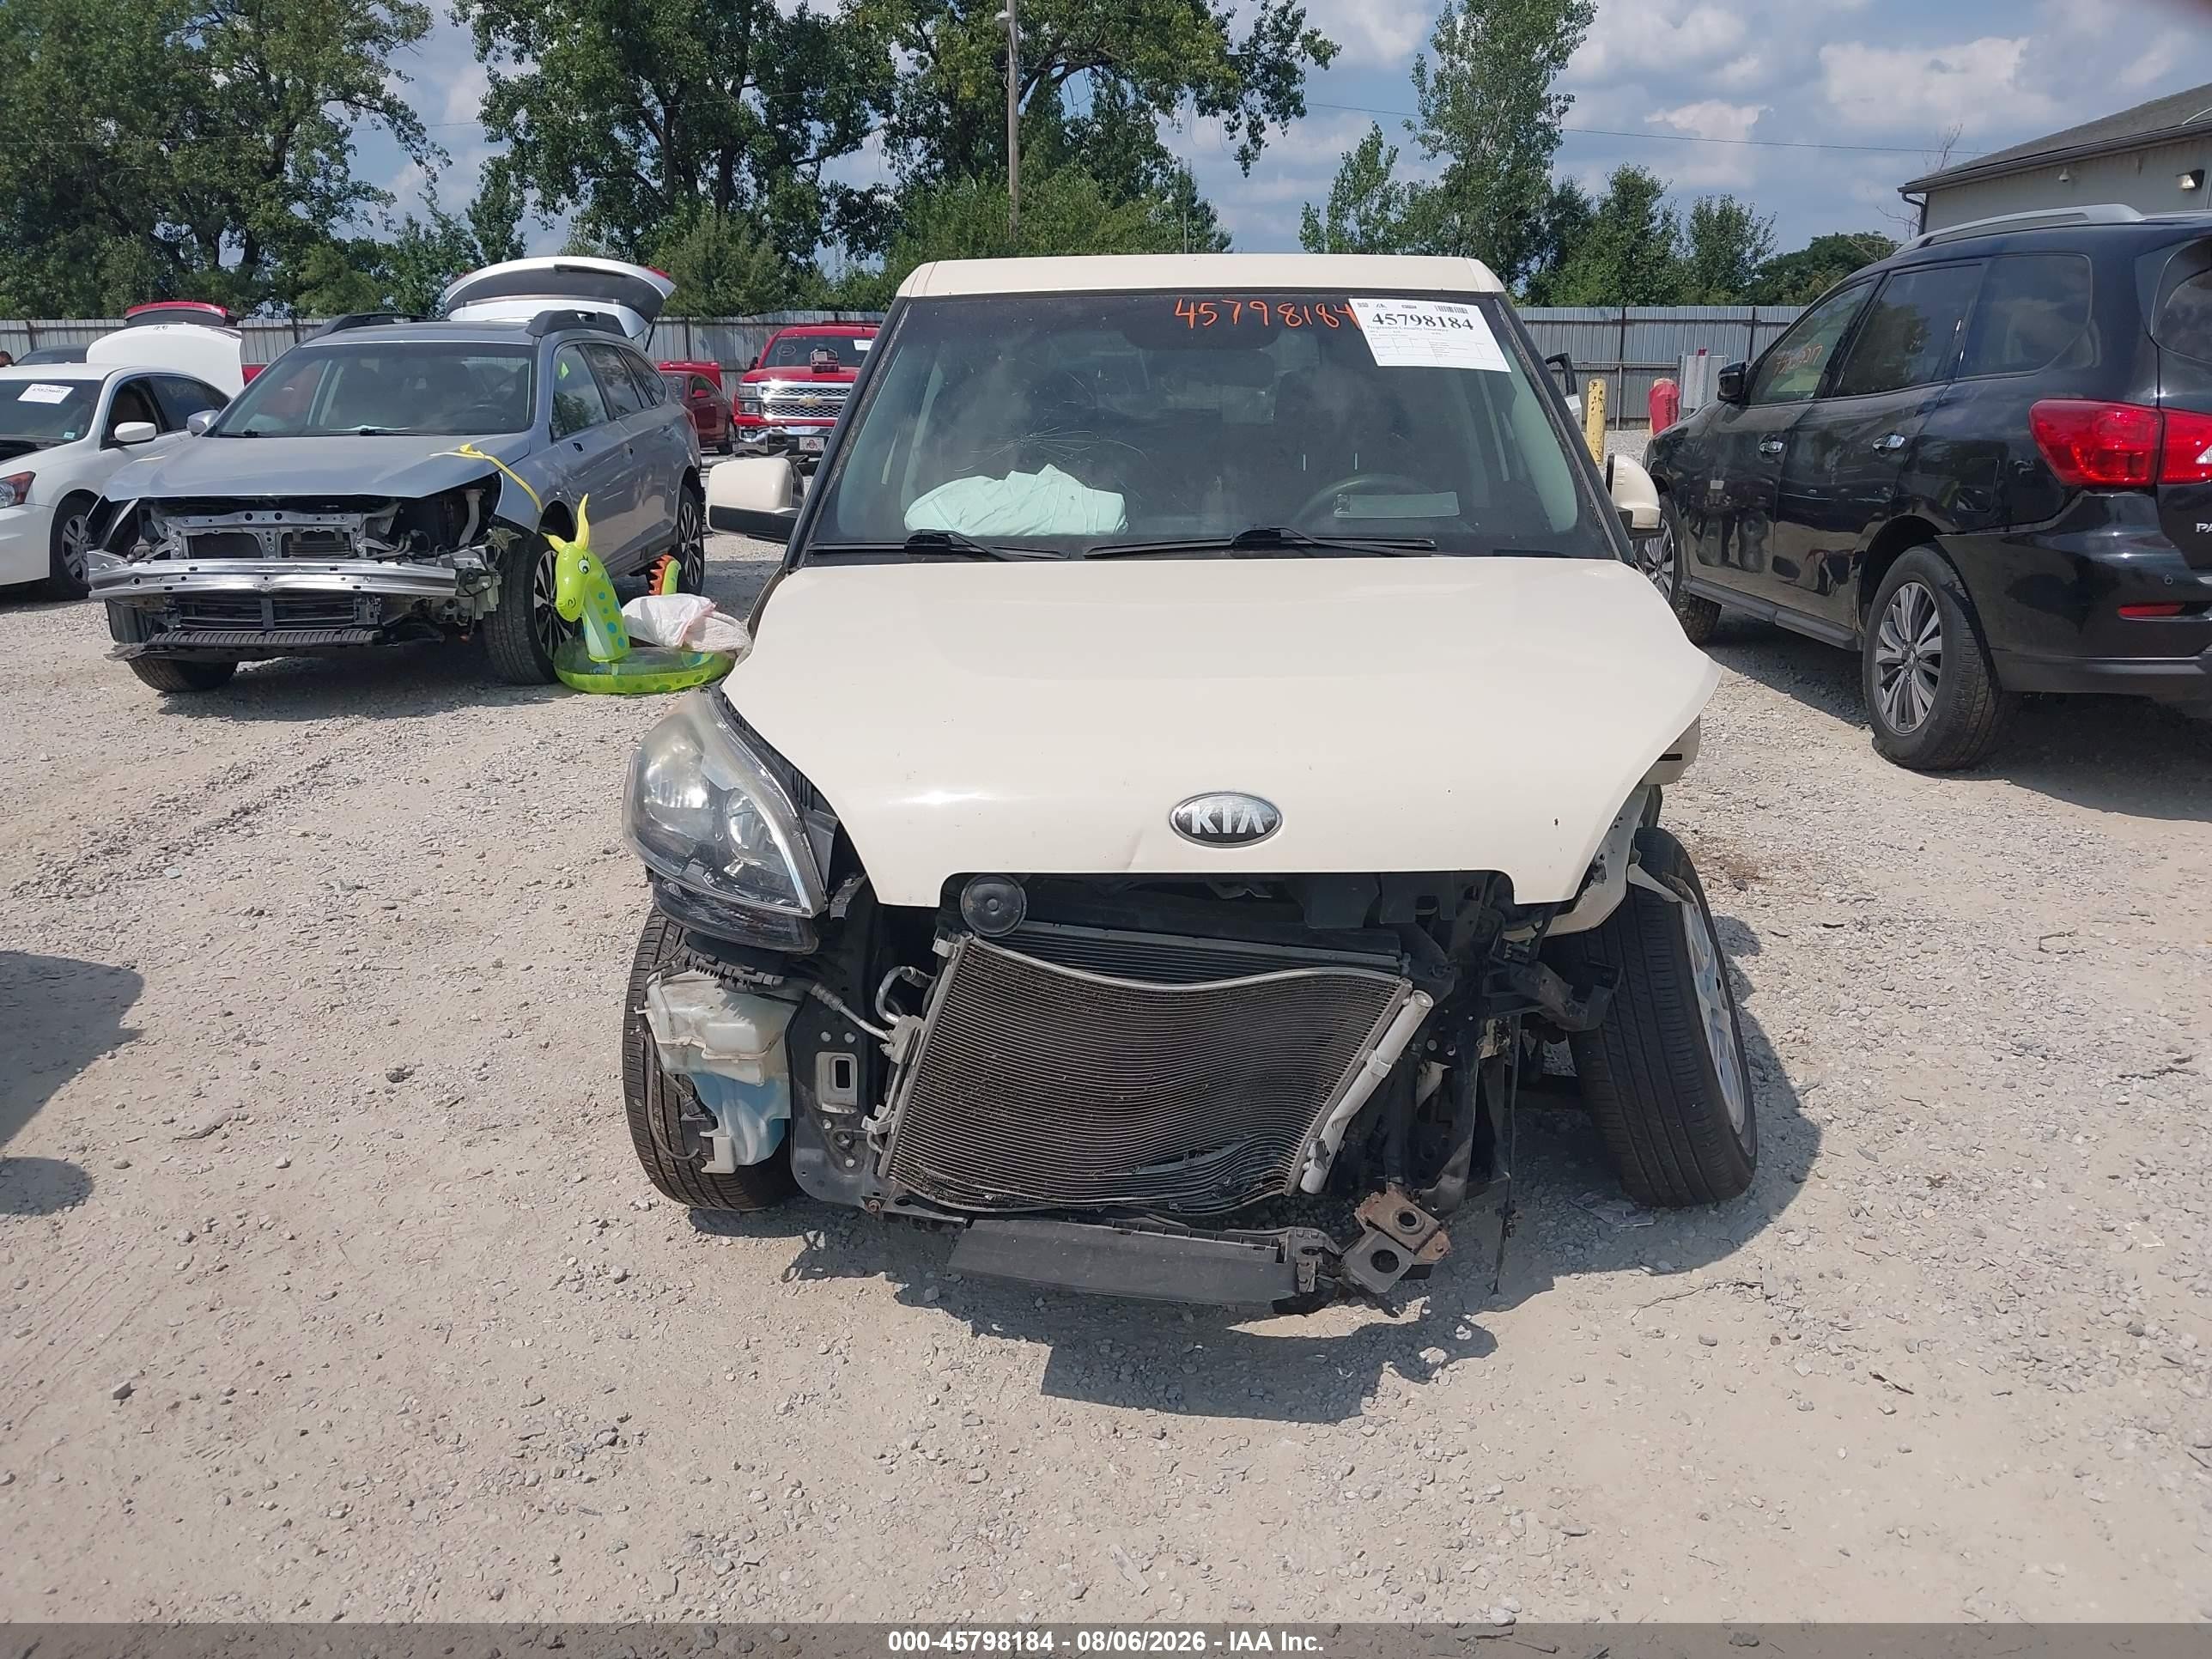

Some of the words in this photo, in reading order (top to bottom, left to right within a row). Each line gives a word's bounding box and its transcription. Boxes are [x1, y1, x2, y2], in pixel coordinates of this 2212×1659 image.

[1175, 298, 1362, 330] 45798184
[1372, 313, 1474, 331] 45798184
[1191, 804, 1266, 834] KIA
